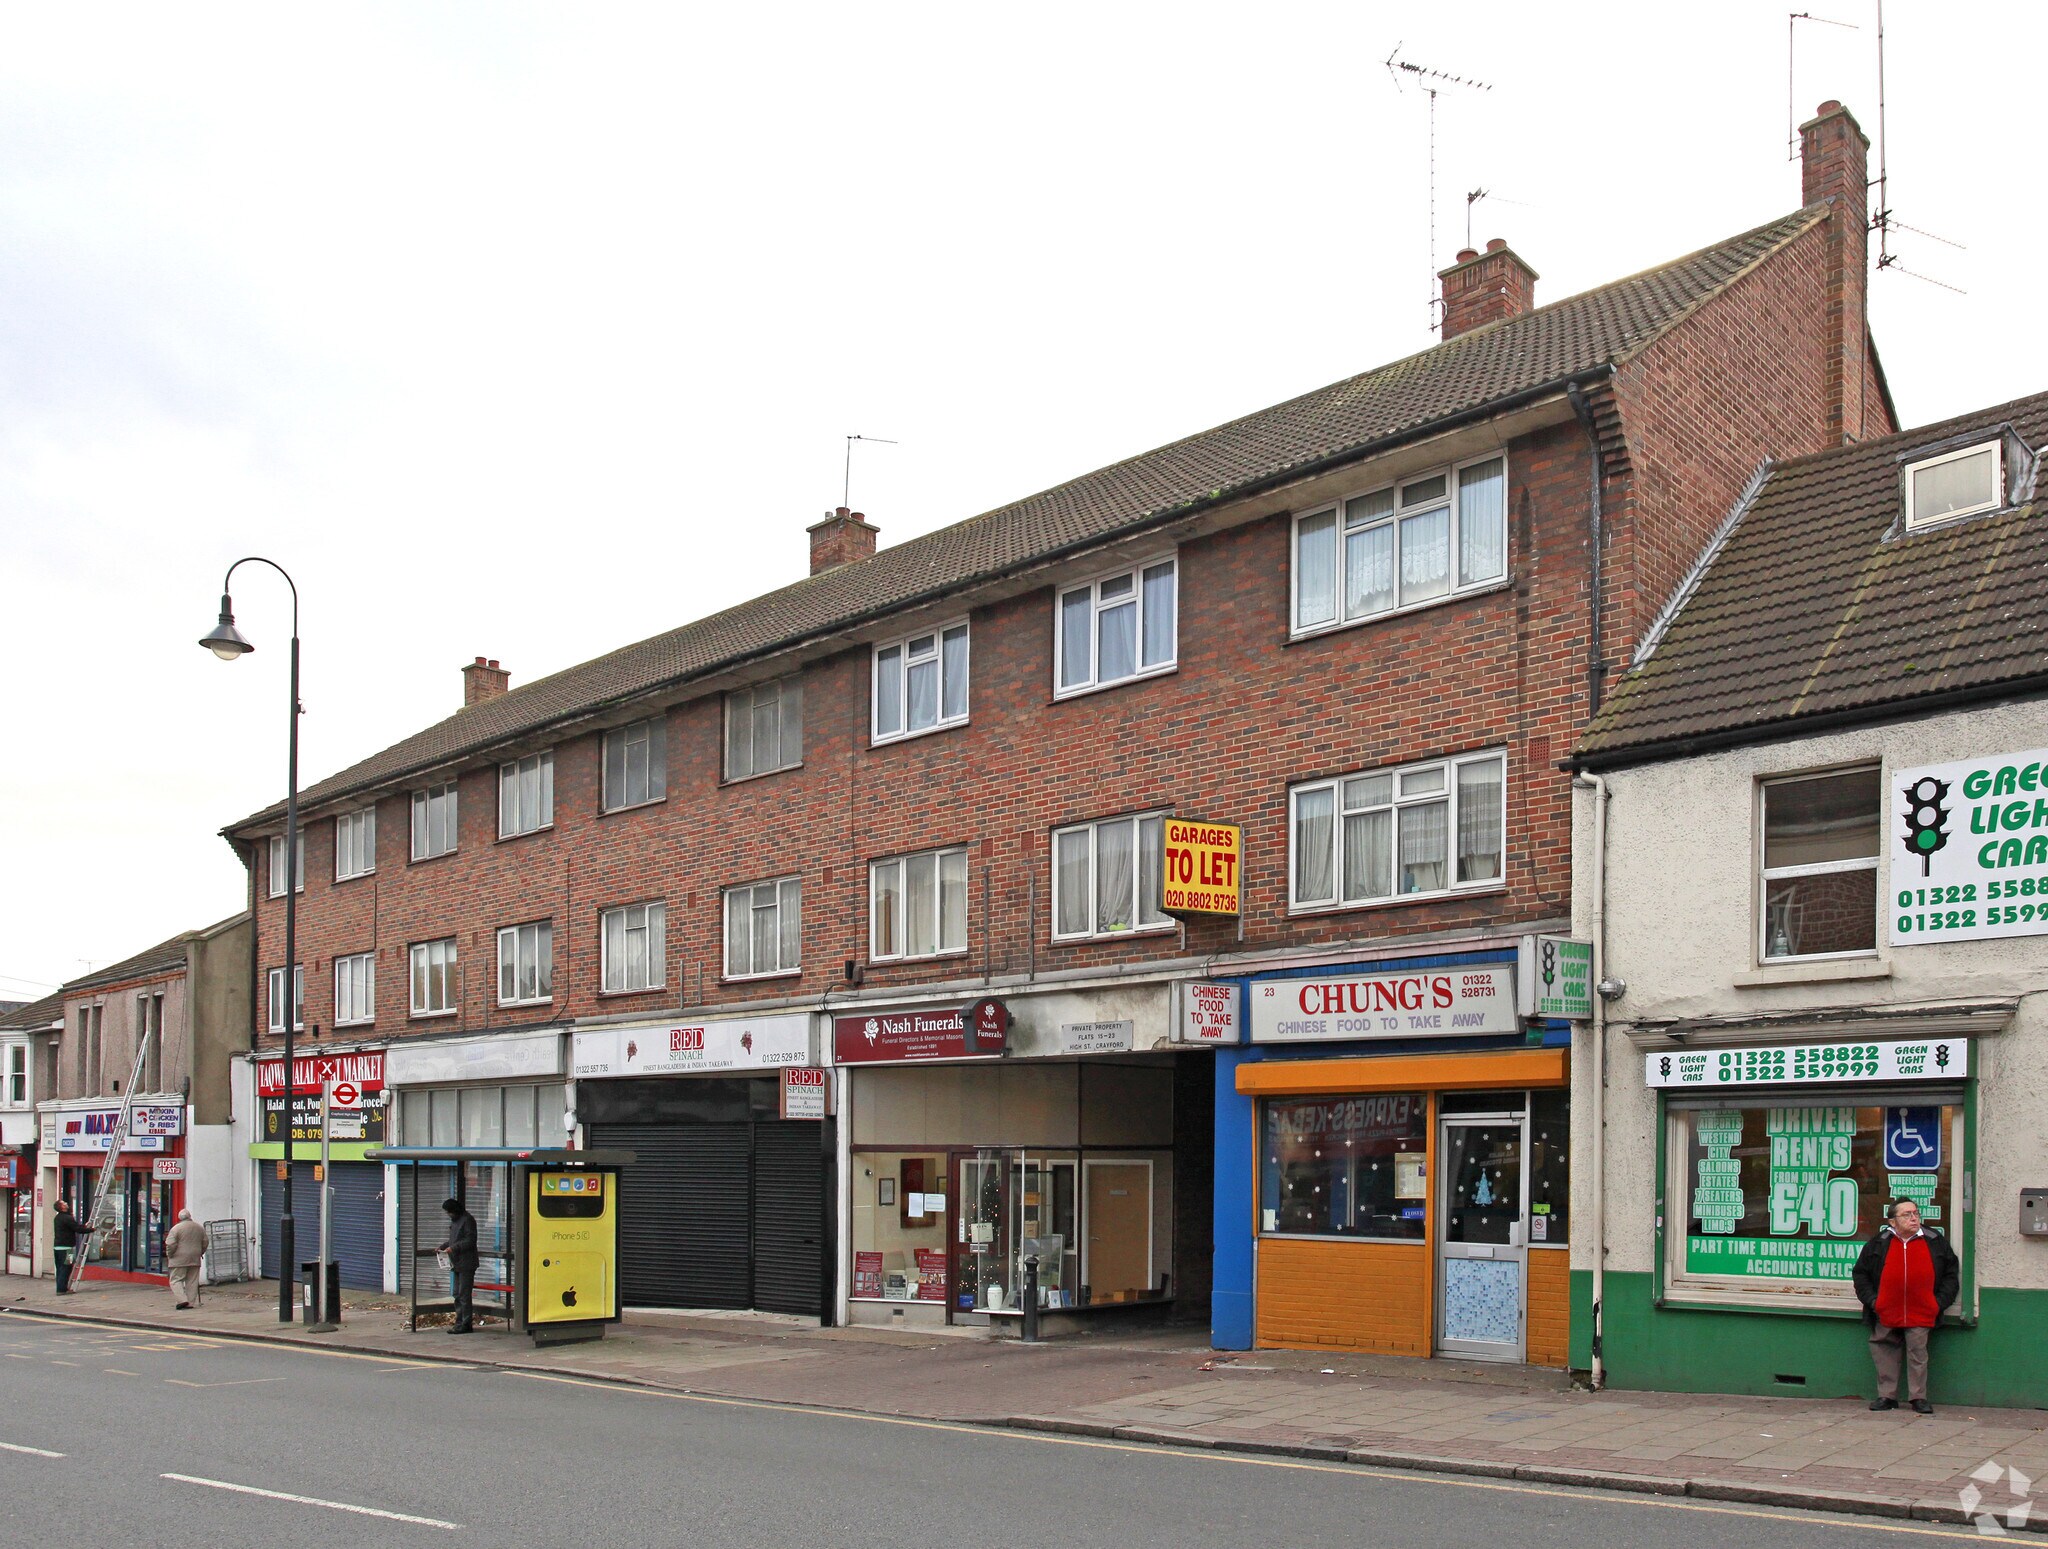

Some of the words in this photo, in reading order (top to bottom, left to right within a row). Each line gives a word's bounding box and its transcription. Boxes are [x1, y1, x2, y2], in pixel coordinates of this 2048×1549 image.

[1170, 825, 1232, 847] GARAGES
[1166, 848, 1193, 884] TO
[1200, 851, 1236, 887] LET
[1166, 889, 1184, 907] 020
[1187, 891, 1211, 909] 8802
[1214, 893, 1236, 911] 9736
[1898, 884, 1977, 908] 01322
[1898, 909, 1976, 932] 01322
[1559, 943, 1589, 960] GREEN
[1561, 961, 1588, 979] LIGHT
[1462, 974, 1492, 986] 01322
[1192, 985, 1230, 999] CHINESE
[1264, 987, 1275, 997] 23
[1299, 975, 1454, 1015] CHUNG'S
[1461, 986, 1496, 998] 528731
[1563, 981, 1586, 998] CARS
[1199, 1000, 1224, 1012] FOOD
[1541, 997, 1563, 1005] 01322
[882, 1019, 911, 1034] Nash
[915, 1013, 963, 1032] Funerals
[1191, 1012, 1203, 1024] TO
[1209, 1013, 1232, 1025] TAKE
[1277, 1020, 1327, 1034] CHINESE
[1337, 1018, 1371, 1032] FOOD
[1380, 1017, 1398, 1030] TO
[1408, 1015, 1441, 1029] TAKE
[1451, 1012, 1485, 1028] AWAY
[982, 1021, 997, 1029] Nash
[898, 1035, 919, 1043] Directors
[924, 1034, 945, 1042] Memorial
[946, 1033, 963, 1041] Masons
[977, 1030, 1002, 1038] Funerals
[1200, 1026, 1223, 1038] AWAY
[670, 1028, 704, 1050] RED
[669, 1050, 703, 1061] SPINACH
[1718, 1050, 1786, 1066] 01322
[1794, 1045, 1879, 1063] 558822
[1894, 1045, 1928, 1055] GREEN
[762, 1053, 779, 1063] 01322
[781, 1053, 792, 1062] 529
[794, 1052, 805, 1061] 875
[1679, 1055, 1707, 1064] GREEN
[1896, 1055, 1926, 1065] LIGHT
[293, 1060, 316, 1085] ALAL
[343, 1055, 383, 1081] MARKET
[321, 1061, 333, 1074] X
[599, 1064, 608, 1072] 735
[1680, 1065, 1705, 1073] LIGHT
[1718, 1065, 1785, 1081] 01322
[1793, 1061, 1879, 1079] 559999
[1898, 1065, 1923, 1074] CARS
[787, 1068, 824, 1086] RED
[1682, 1074, 1703, 1082] CARS
[787, 1086, 823, 1094] SPINACH
[267, 1099, 285, 1111] Halal
[292, 1100, 306, 1111] eat,
[1698, 1116, 1742, 1130] AIRPORTS
[1769, 1108, 1855, 1133] DRIVER
[1700, 1132, 1740, 1144] WESTEND
[1710, 1147, 1729, 1158] CITY
[1773, 1136, 1850, 1168] RENTS
[1700, 1161, 1740, 1173] SALOONS
[1701, 1176, 1737, 1187] ESTATES
[1774, 1172, 1799, 1183] FROM
[1802, 1172, 1825, 1183] ONLY
[1890, 1176, 1912, 1185] WHEEL
[1914, 1176, 1935, 1185] CHAIR
[1696, 1190, 1703, 1202] 7
[1704, 1191, 1742, 1202] SEATERS
[1893, 1187, 1933, 1195] ACCESSIBLE
[1695, 1204, 1743, 1217] MINIBUSES
[1772, 1180, 1856, 1235] £40
[1703, 1219, 1733, 1231] LIMO'S
[552, 1231, 575, 1240] iPhone
[576, 1231, 581, 1240] 5
[1691, 1239, 1723, 1253] PART
[1728, 1240, 1756, 1255] TIME
[1761, 1241, 1814, 1257] DRIVERS
[1819, 1243, 1864, 1259] ALWAY
[1746, 1259, 1814, 1276] ACCOUNTS
